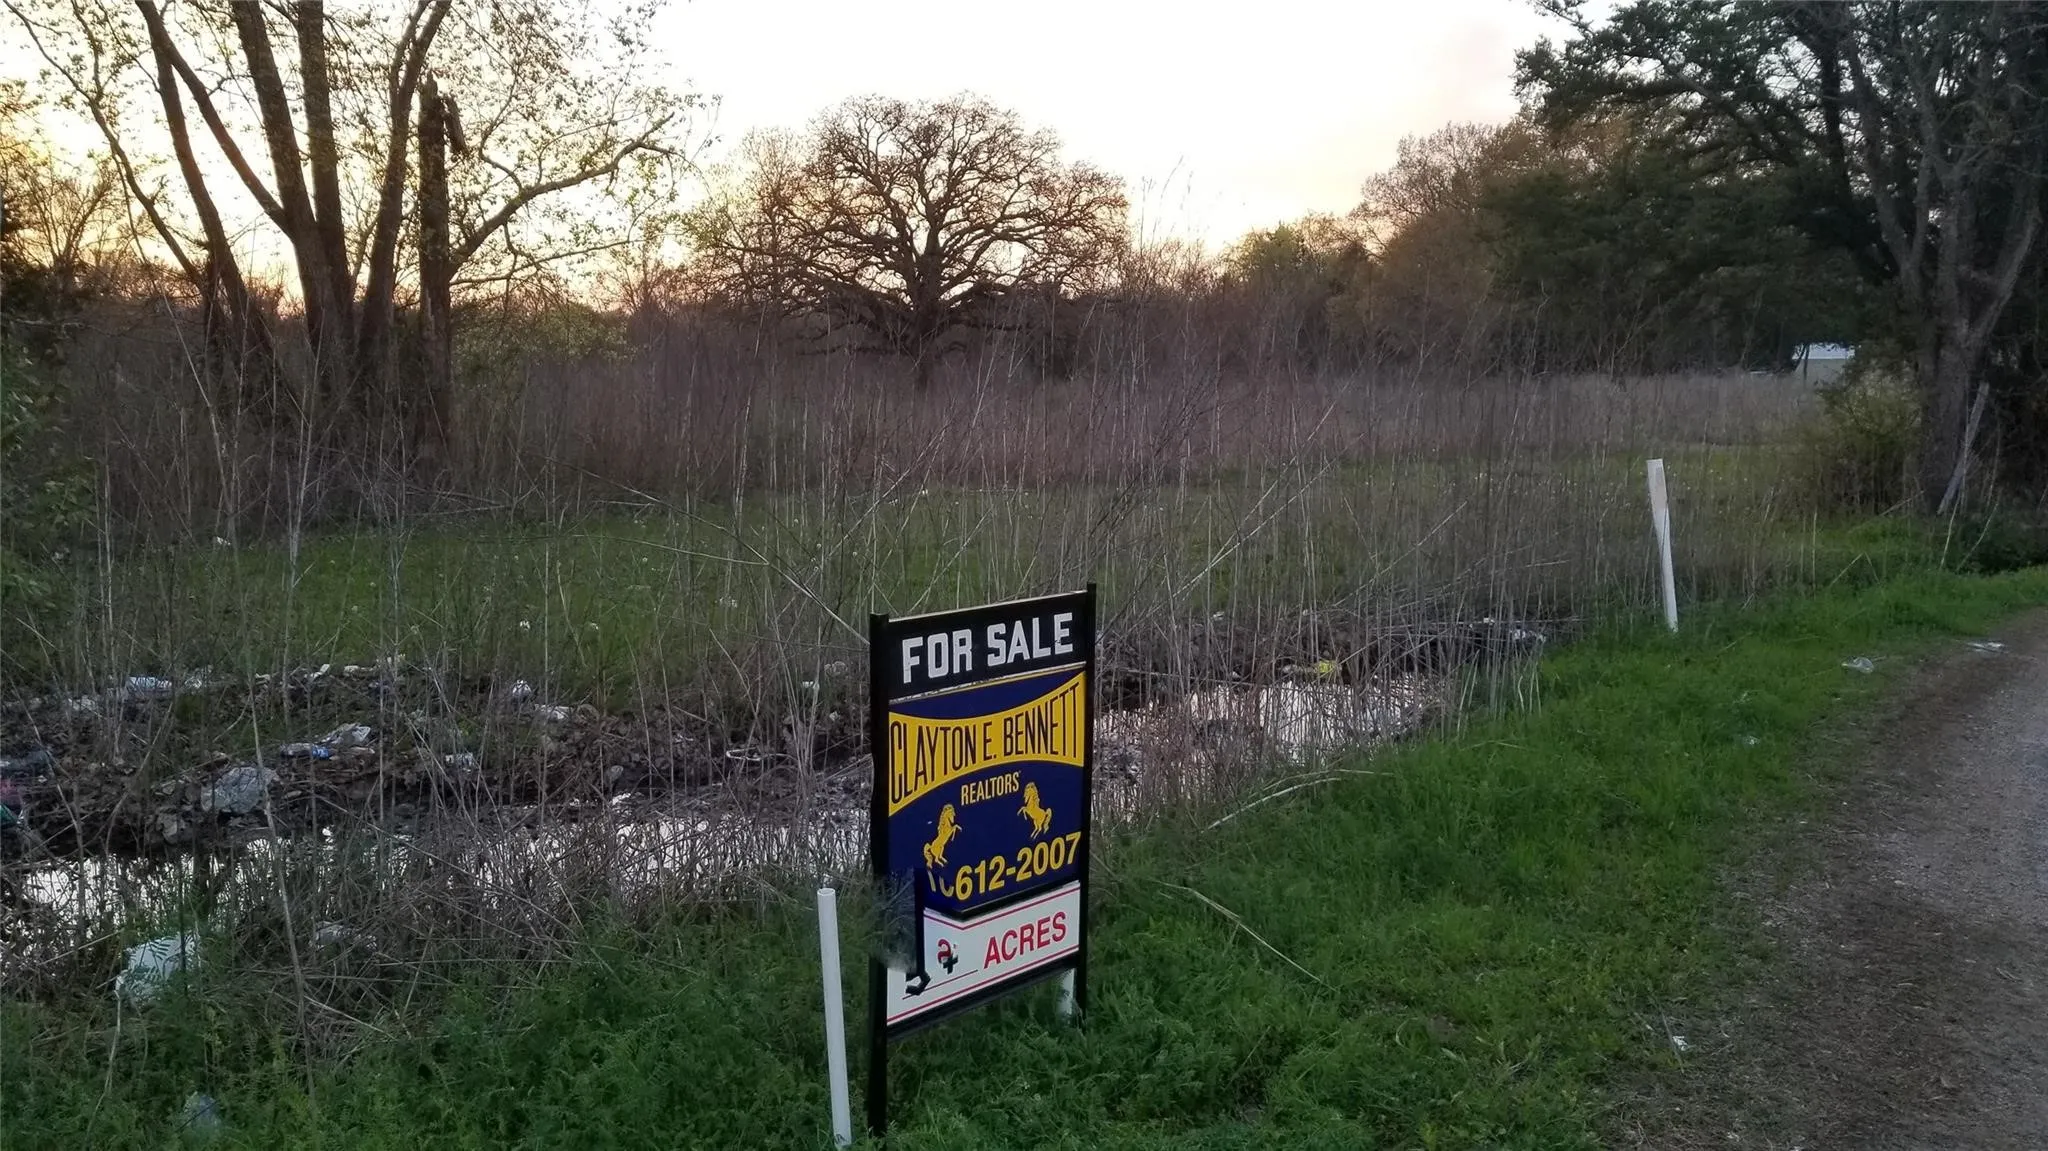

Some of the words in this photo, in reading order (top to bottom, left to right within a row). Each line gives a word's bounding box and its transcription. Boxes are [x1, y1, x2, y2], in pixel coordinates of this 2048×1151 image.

[902, 628, 973, 684] FOR
[987, 612, 1073, 667] SALE
[889, 720, 977, 805] CLAYTON
[983, 721, 997, 761] E.
[1003, 681, 1080, 758] BENNETT
[961, 771, 1020, 806] REALTORS
[983, 911, 1067, 970] ACRES
